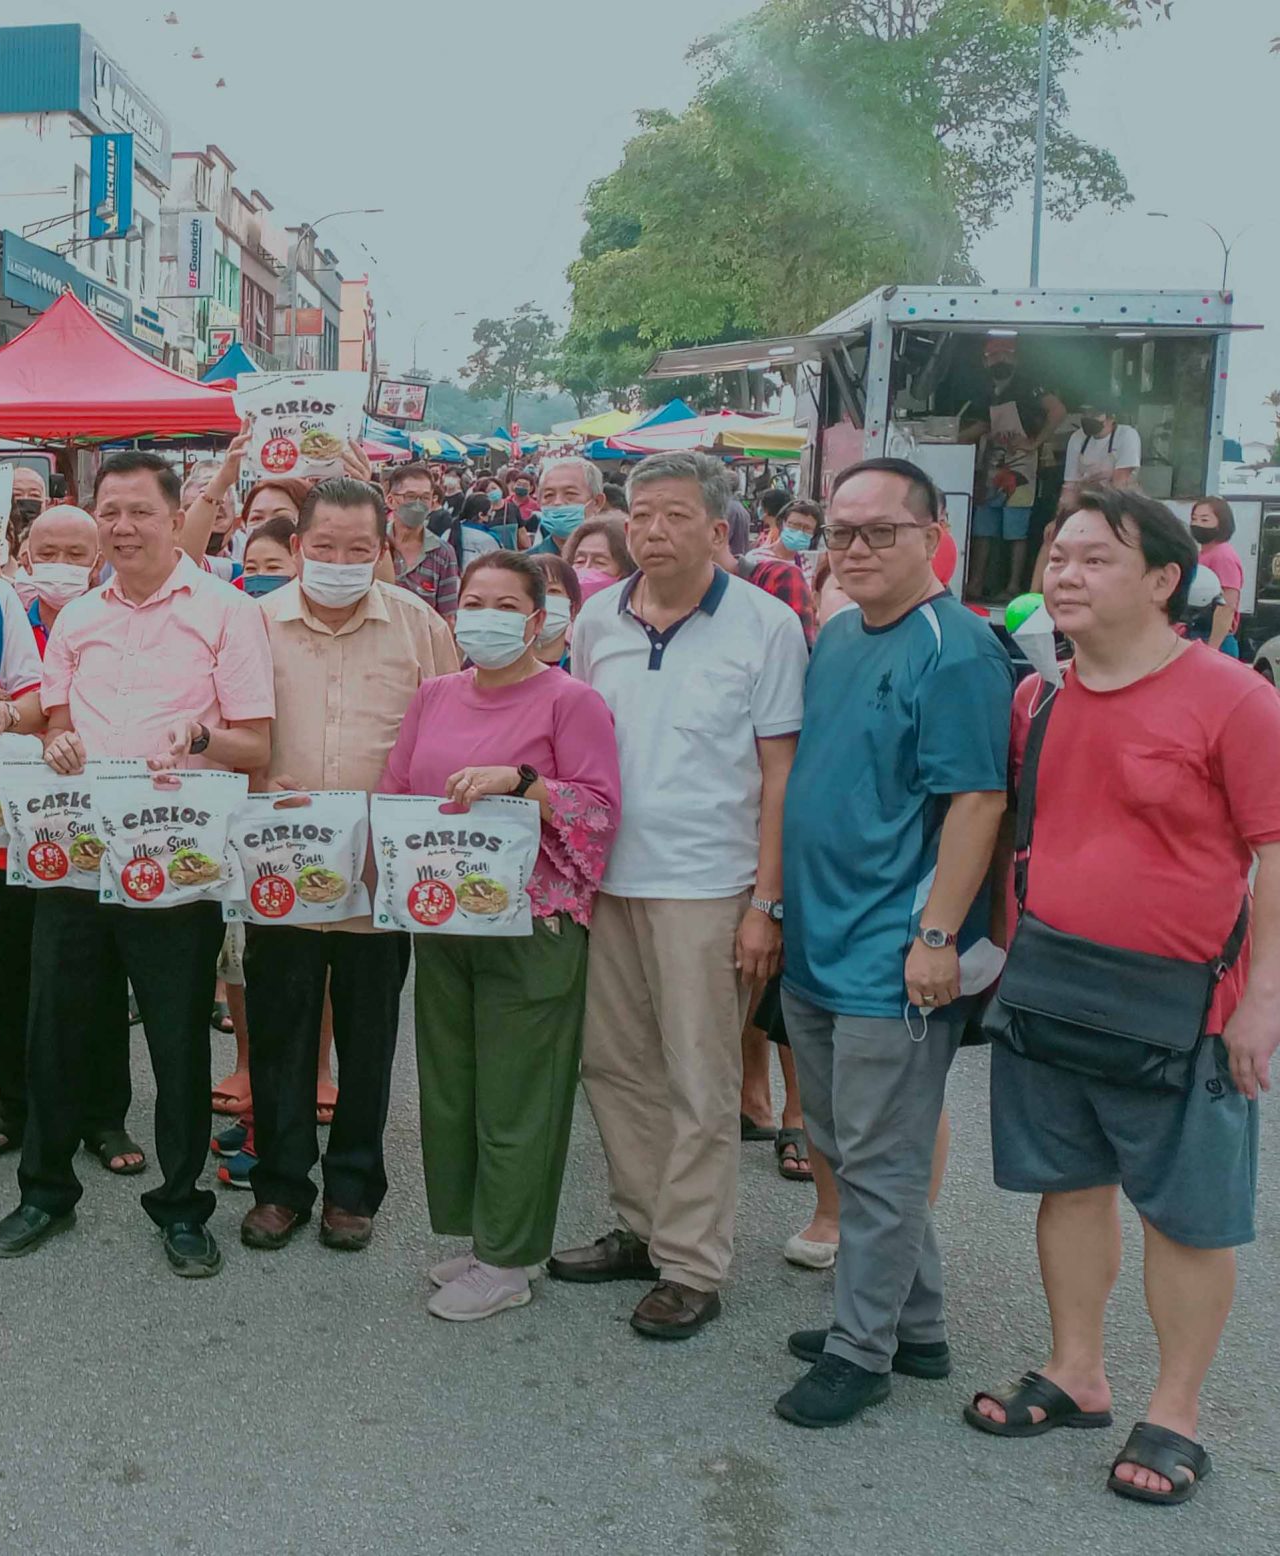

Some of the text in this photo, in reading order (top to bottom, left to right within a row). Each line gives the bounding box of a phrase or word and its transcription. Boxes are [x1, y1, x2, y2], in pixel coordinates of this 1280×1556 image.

[188, 218, 200, 289] BFGoodrich
[261, 400, 336, 416] CARLOS
[27, 791, 91, 814] CARLO
[122, 806, 211, 830] CARLOS
[35, 828, 66, 842] Mee
[244, 824, 335, 849] CARLOS
[405, 830, 503, 853] CARLOS
[132, 843, 164, 859] Mee
[257, 861, 289, 876] Mee
[416, 865, 452, 881] Mee
